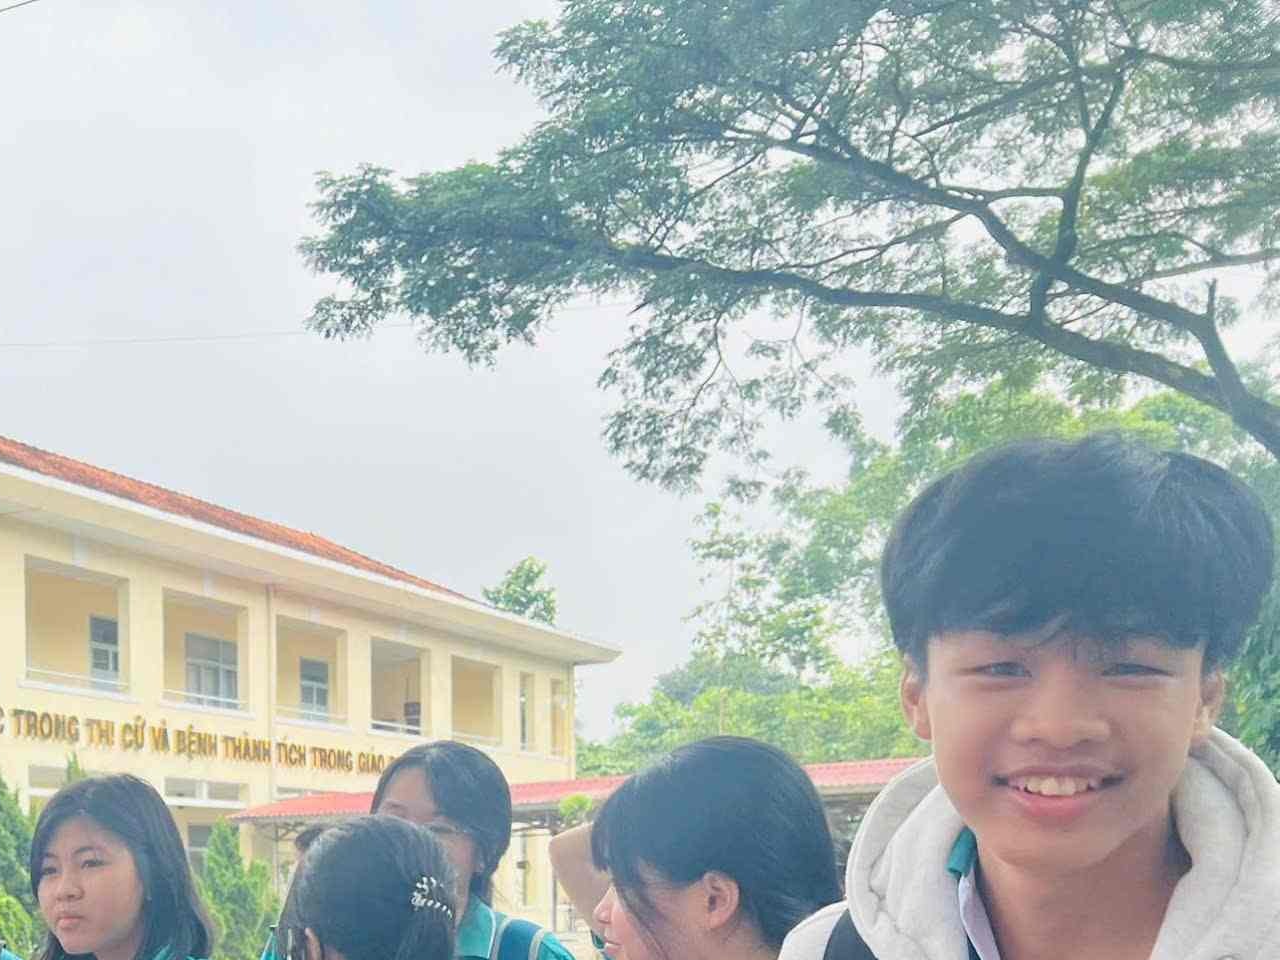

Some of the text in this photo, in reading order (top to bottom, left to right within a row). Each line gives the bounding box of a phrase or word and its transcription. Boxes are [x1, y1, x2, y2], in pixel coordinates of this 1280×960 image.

[13, 708, 79, 744] TRONG
[86, 718, 115, 748] THI
[222, 731, 272, 765] THÀNH
[276, 736, 306, 768] TÍCH
[311, 746, 353, 774] TRONG
